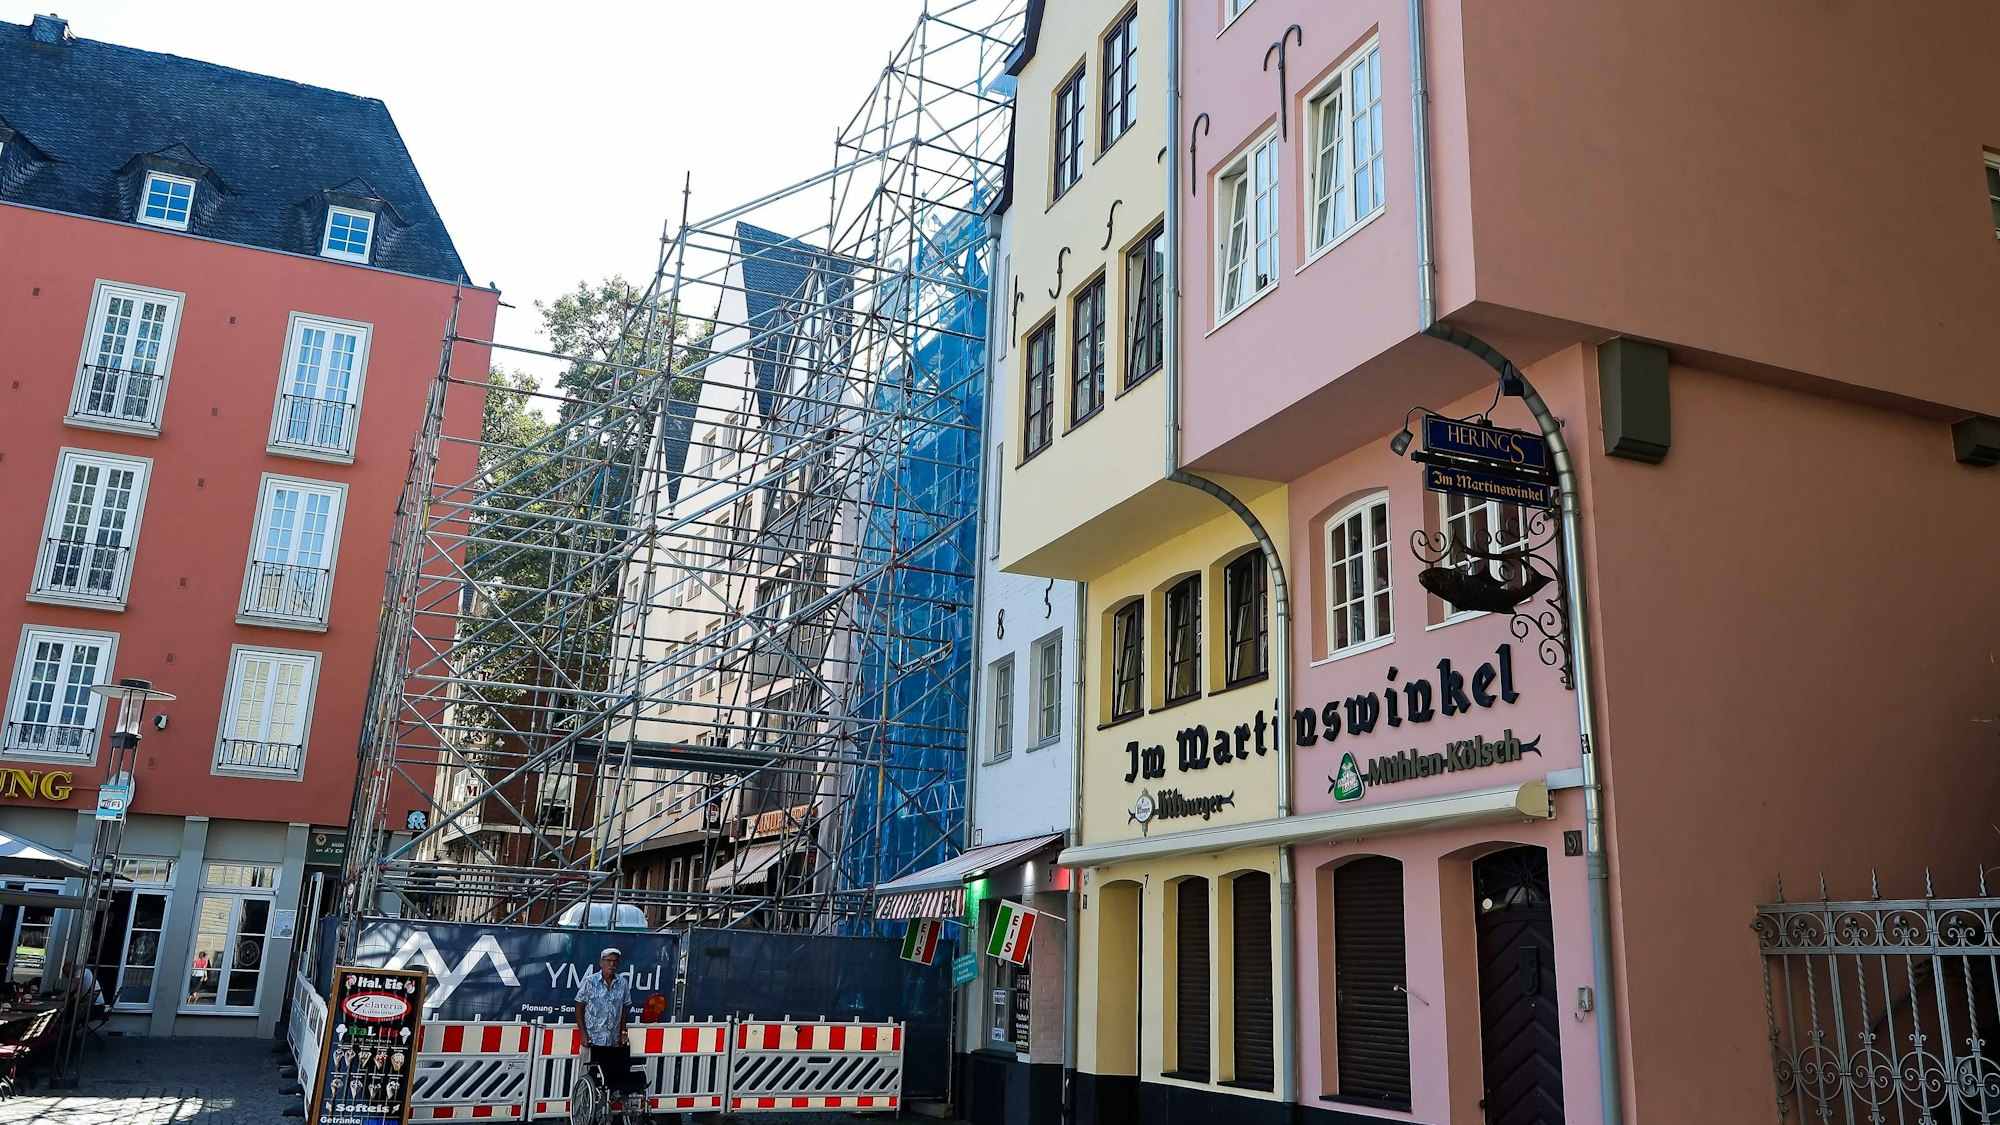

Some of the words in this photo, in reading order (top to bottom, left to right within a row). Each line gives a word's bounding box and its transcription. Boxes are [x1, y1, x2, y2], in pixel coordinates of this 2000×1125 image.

[1447, 425, 1526, 464] HERINGS
[1432, 470, 1453, 486] Im
[1457, 473, 1544, 502] Martinswinkel
[1124, 740, 1166, 783] Im
[1157, 787, 1223, 821] Bitburger
[1144, 873, 1150, 889] 7
[915, 922, 928, 956] EIS
[1003, 914, 1020, 953] EIS
[357, 976, 382, 989] Ital.
[384, 978, 404, 990] Eis
[545, 961, 661, 991] YMdul
[351, 996, 403, 1011] Gelateria
[521, 1004, 553, 1014] Planung
[560, 1004, 576, 1013] San
[320, 1115, 361, 1125] Getränke
[335, 1103, 390, 1113] Softeis
